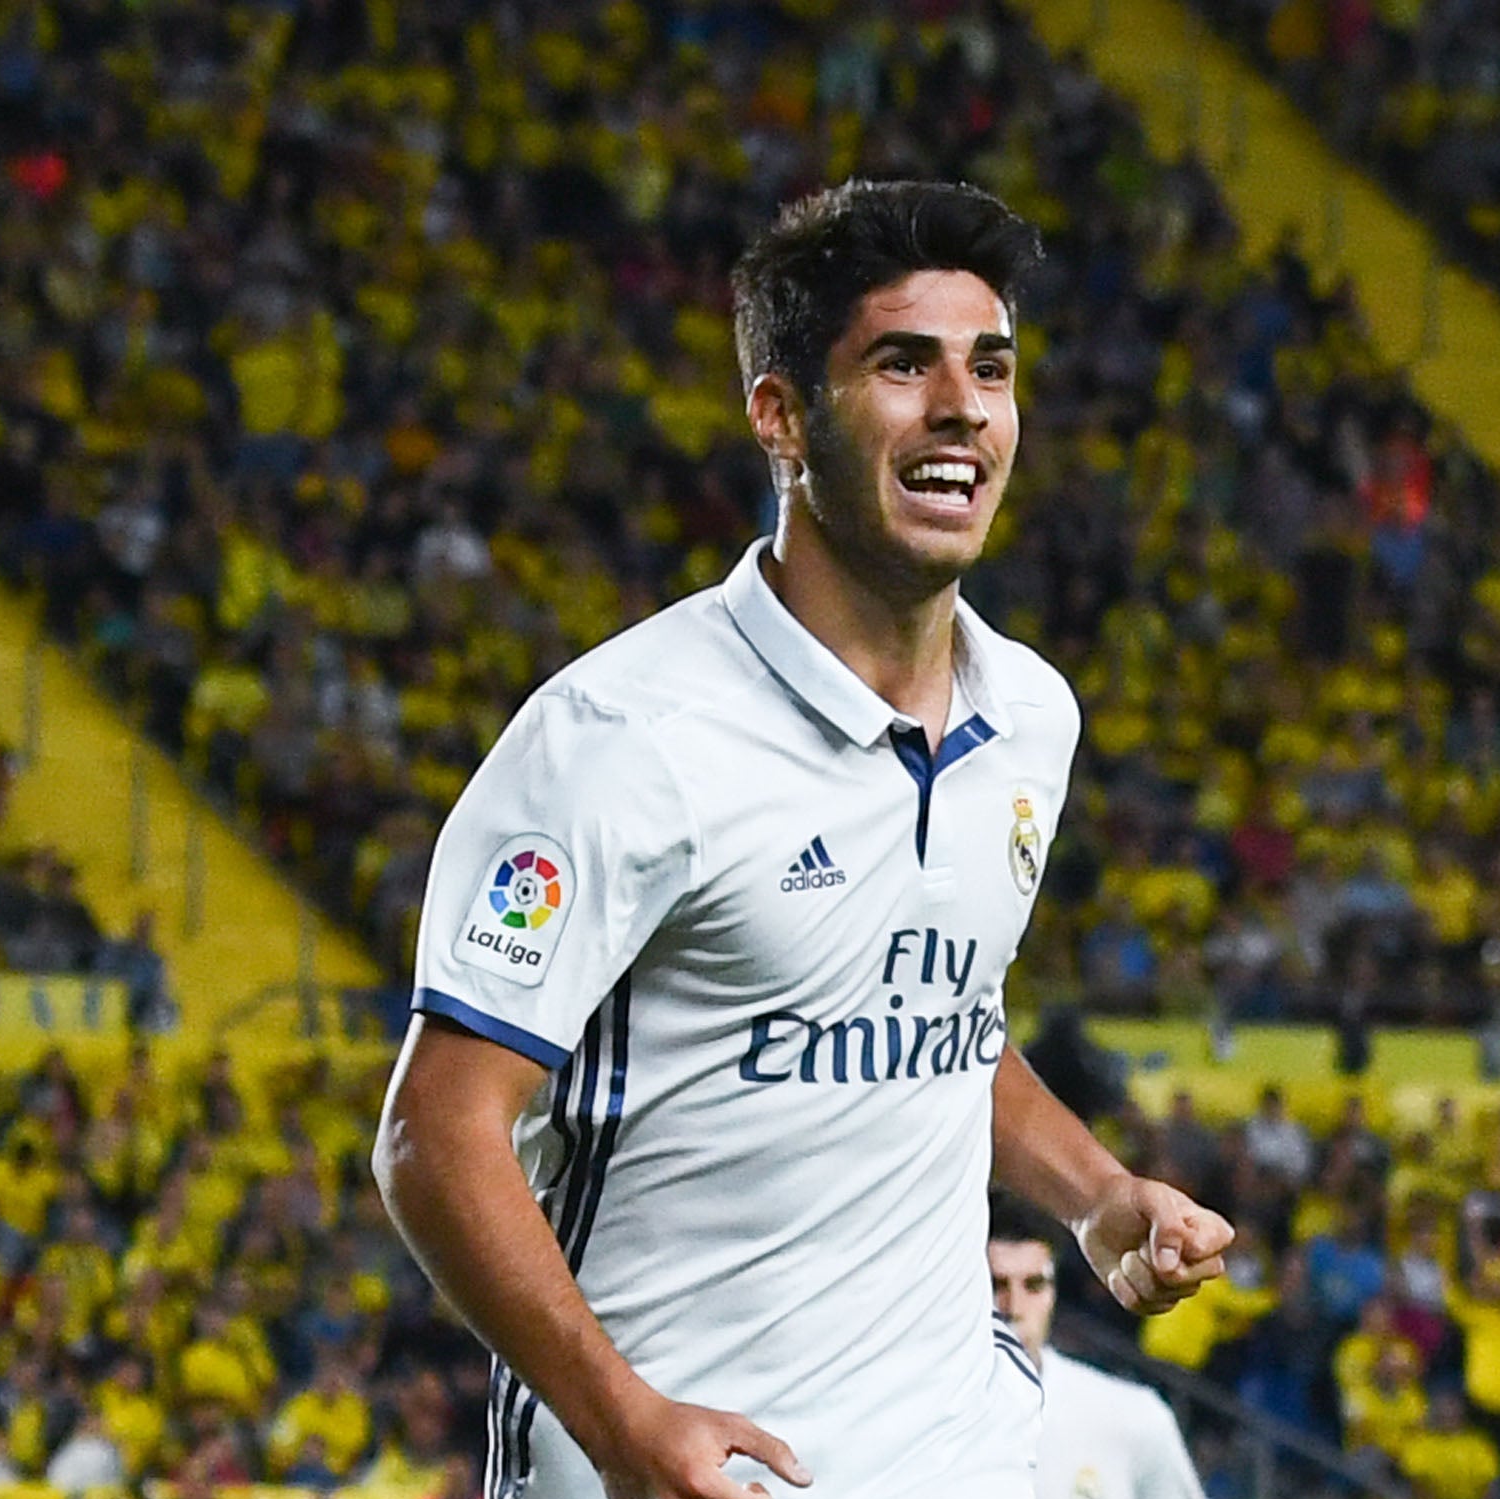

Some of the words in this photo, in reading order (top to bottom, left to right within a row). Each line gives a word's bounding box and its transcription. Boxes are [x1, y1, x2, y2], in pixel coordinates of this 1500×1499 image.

[780, 868, 846, 893] adidas
[466, 924, 542, 966] LaLiga
[882, 927, 978, 997] Fly
[739, 994, 1005, 1084] Emirate
